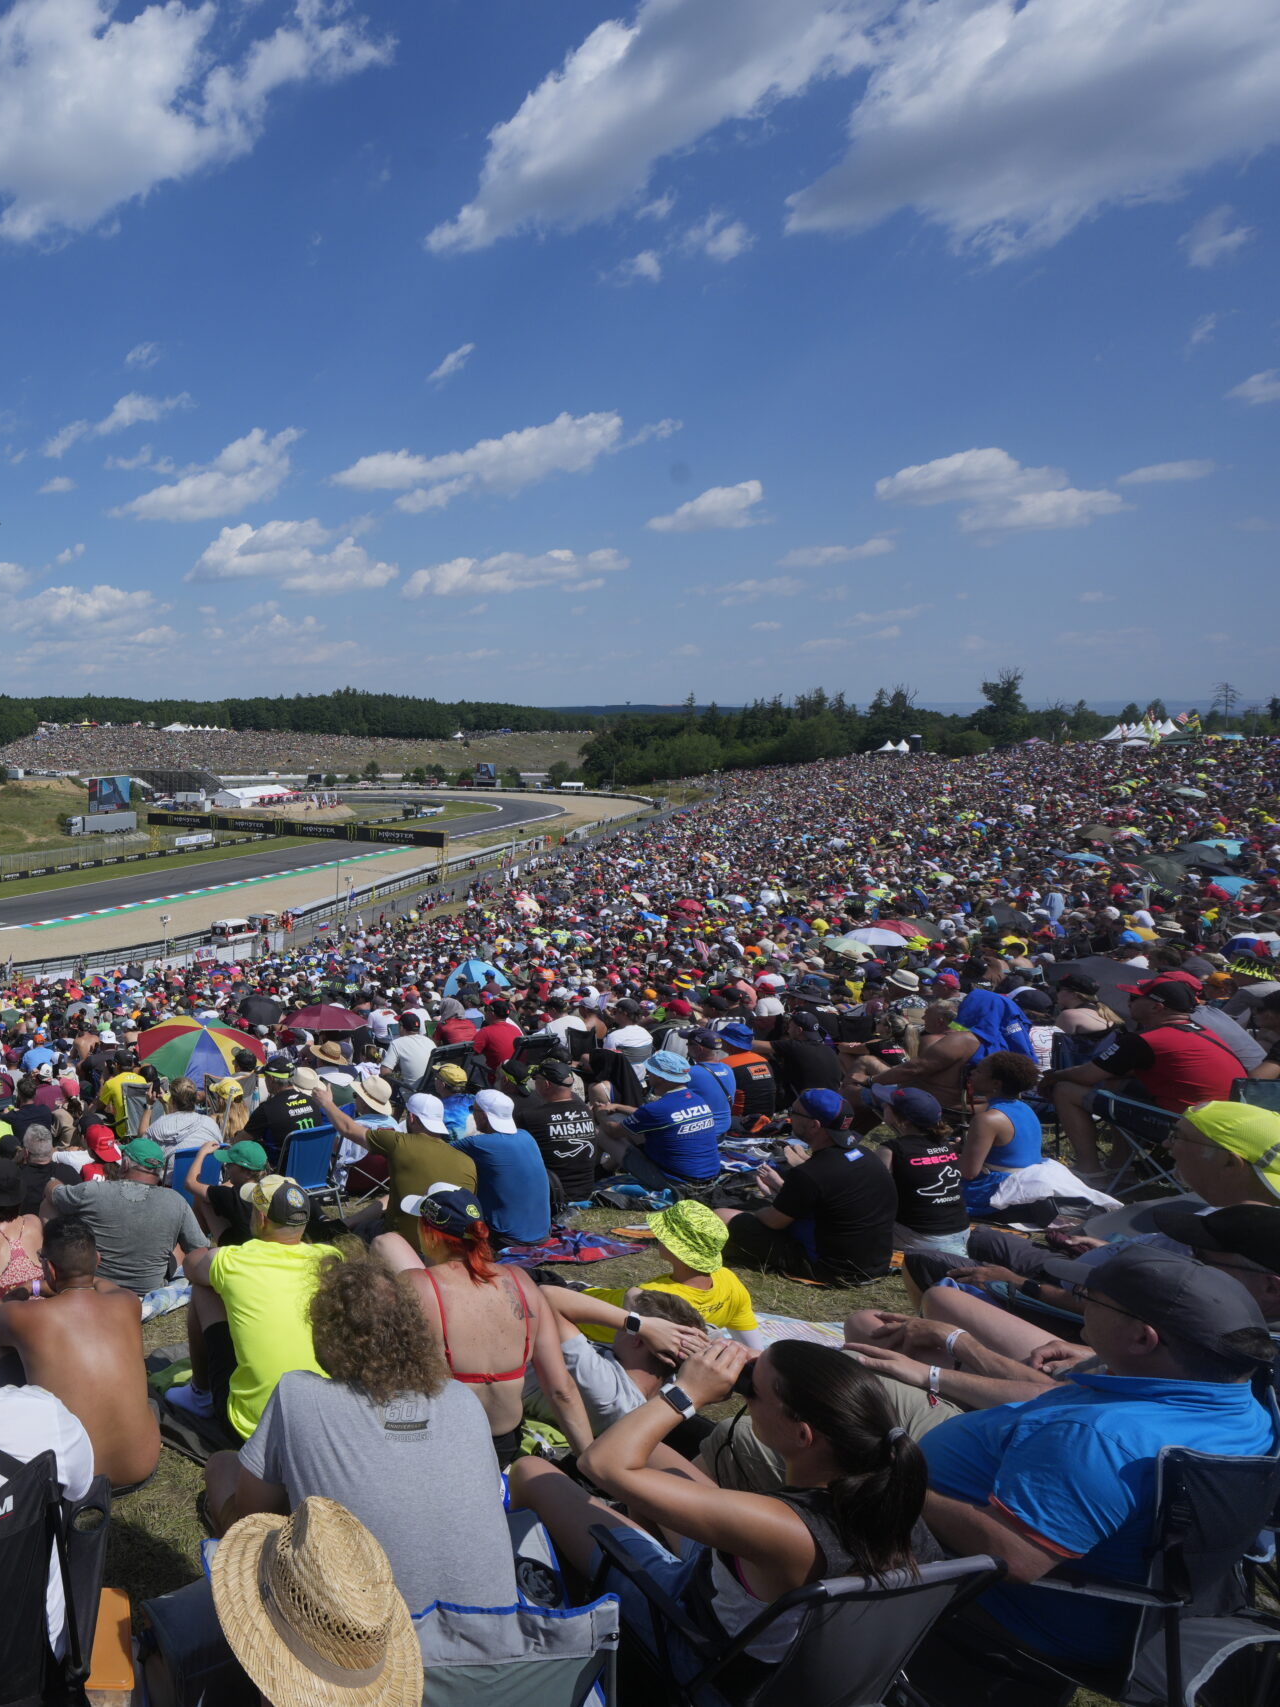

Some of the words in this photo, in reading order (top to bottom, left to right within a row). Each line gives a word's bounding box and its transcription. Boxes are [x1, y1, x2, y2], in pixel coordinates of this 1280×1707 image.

[234, 821, 264, 829] MONSTER
[302, 825, 335, 834] MONSTER
[377, 831, 414, 839] MONSTER
[551, 1113, 562, 1121] 20
[549, 1121, 595, 1137] MISANO
[927, 1146, 949, 1154] BRNO
[385, 1401, 418, 1421] 60
